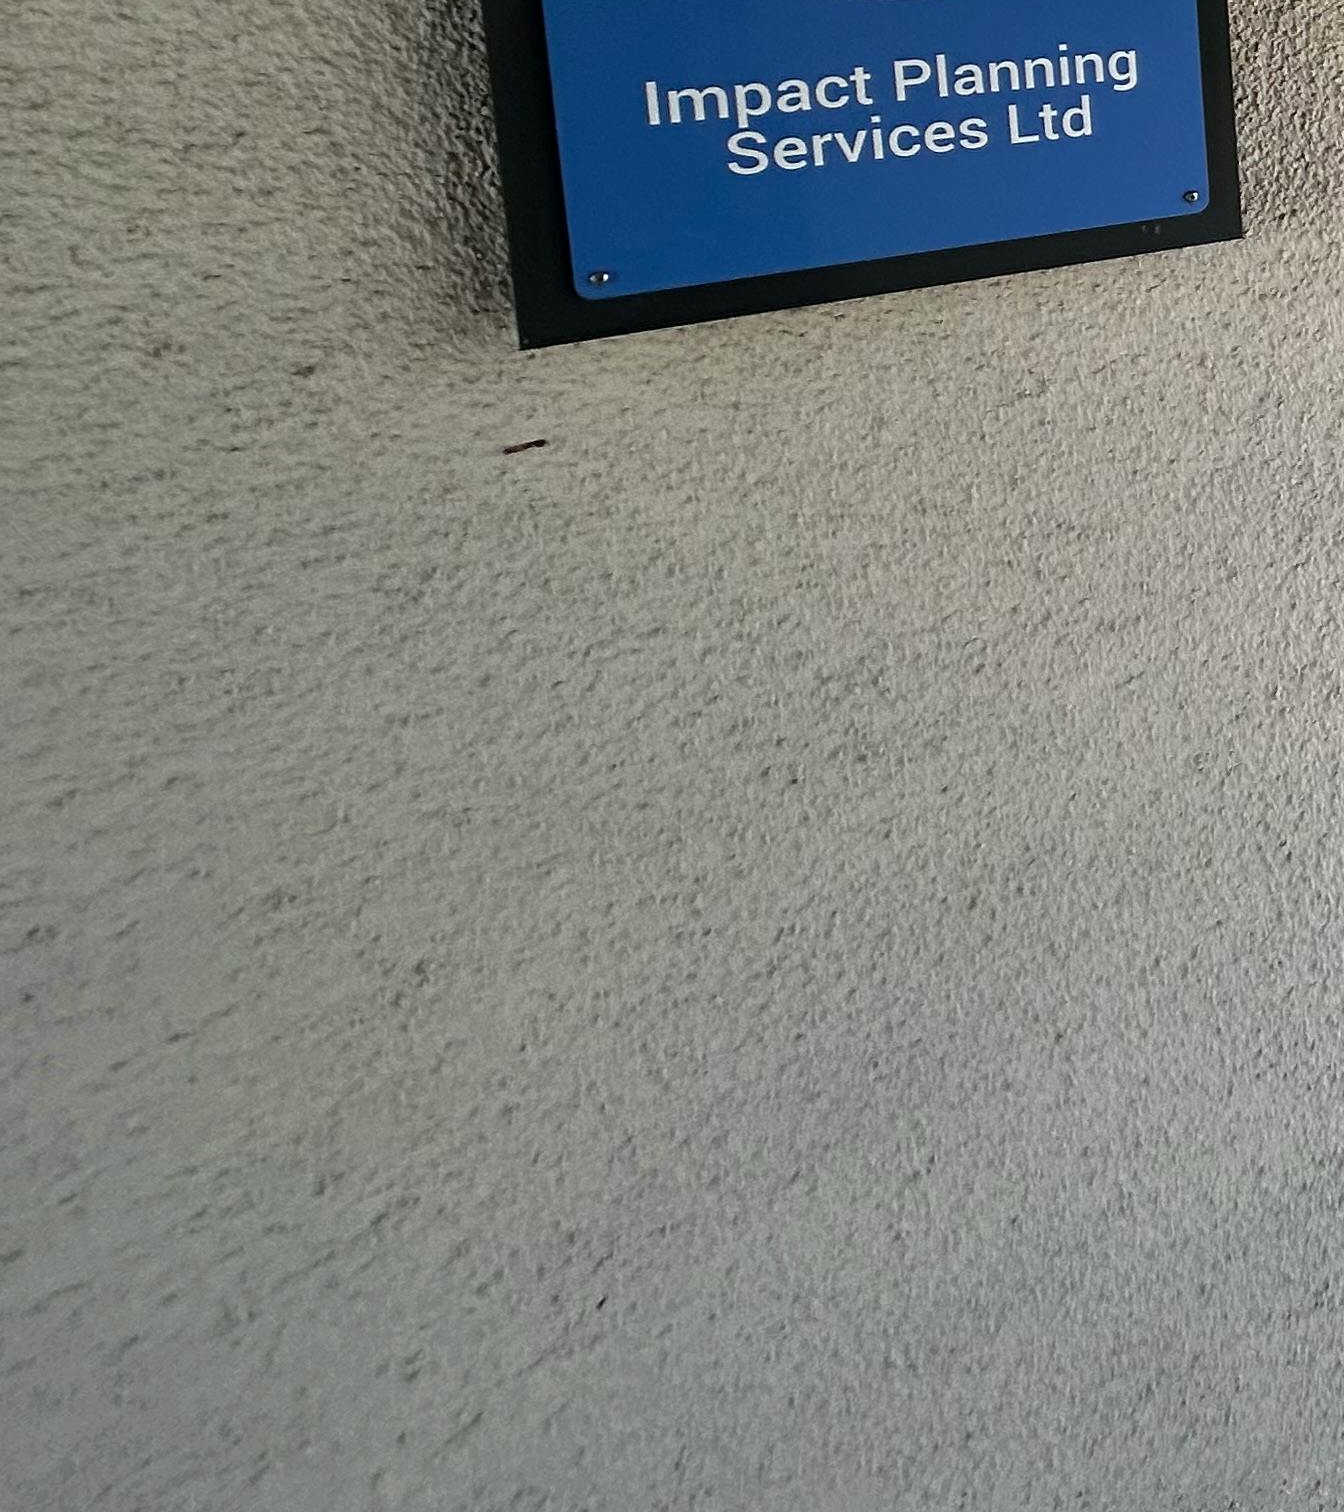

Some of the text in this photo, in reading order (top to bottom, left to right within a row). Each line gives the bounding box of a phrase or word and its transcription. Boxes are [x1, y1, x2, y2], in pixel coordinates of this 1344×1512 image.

[645, 43, 1139, 127] Impact Planning
[726, 95, 1093, 176] Services Ltd
